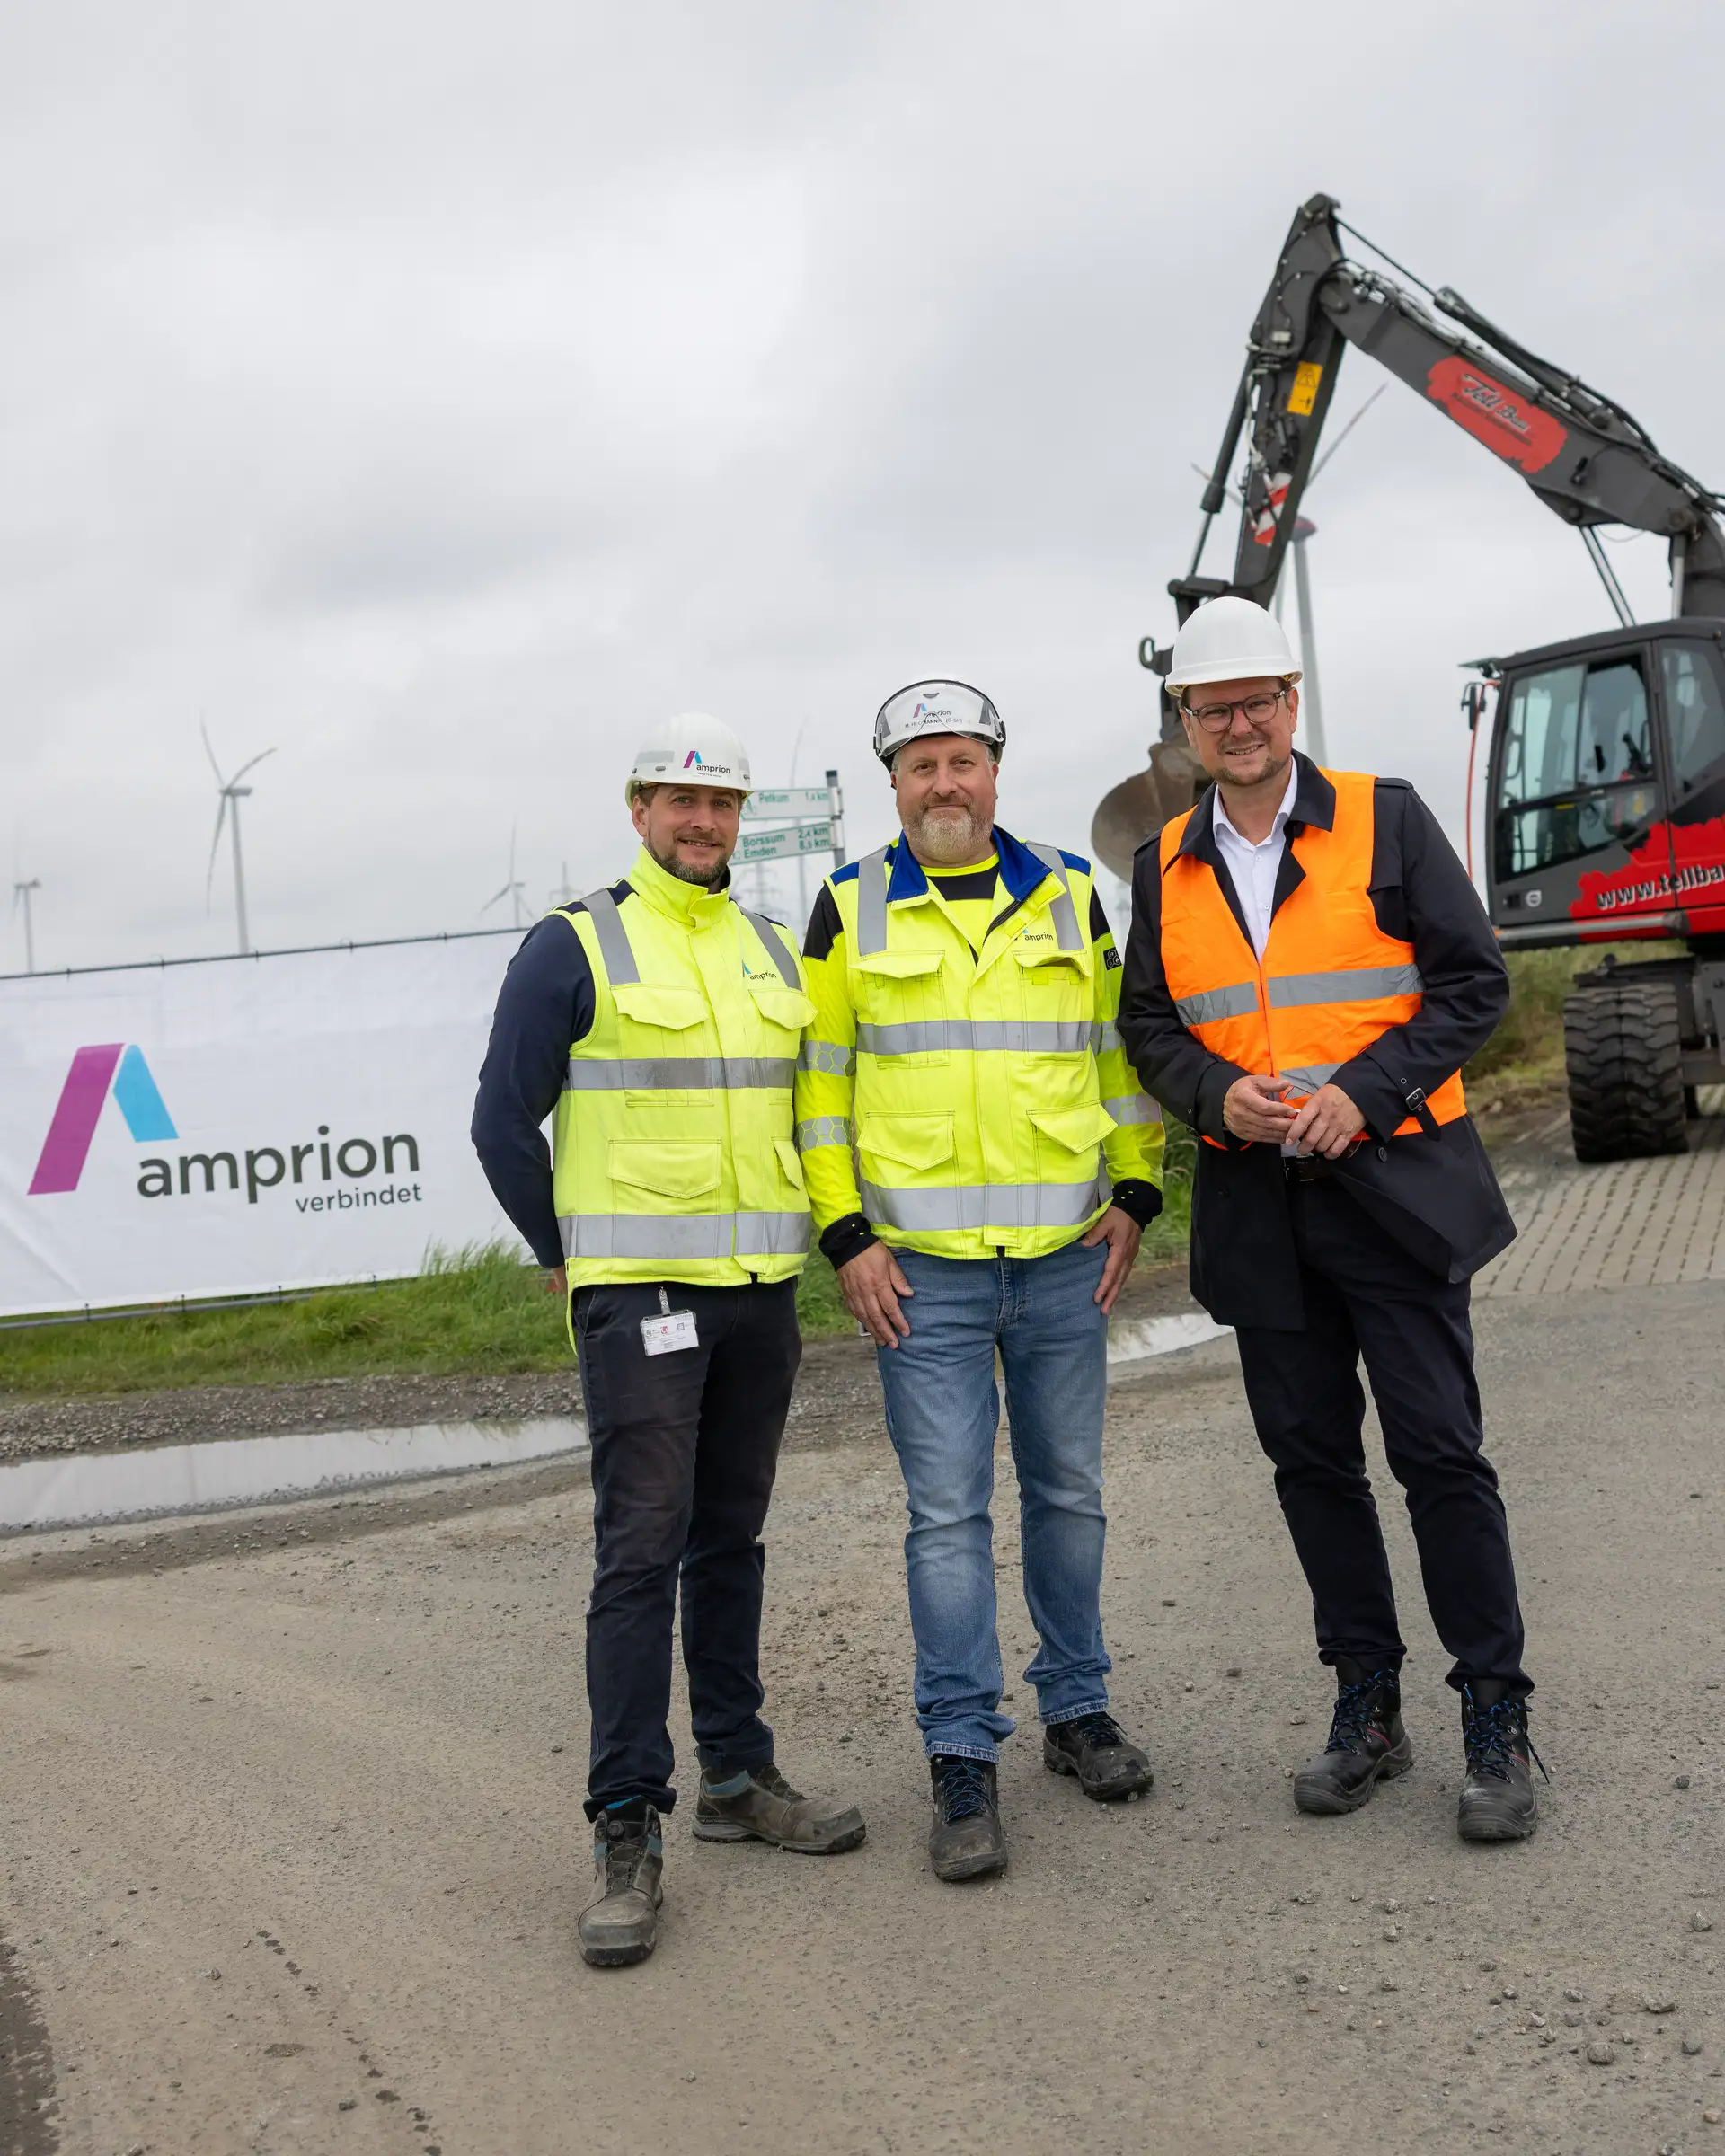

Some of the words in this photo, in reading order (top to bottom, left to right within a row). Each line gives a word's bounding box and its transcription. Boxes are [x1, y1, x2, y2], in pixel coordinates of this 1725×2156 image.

[696, 764, 730, 773] amprion
[743, 834, 785, 847] Borssum
[744, 845, 777, 859] Emden
[1597, 863, 1725, 909] www.tellba
[137, 1125, 420, 1204] amprion
[295, 1183, 422, 1214] verbindet
